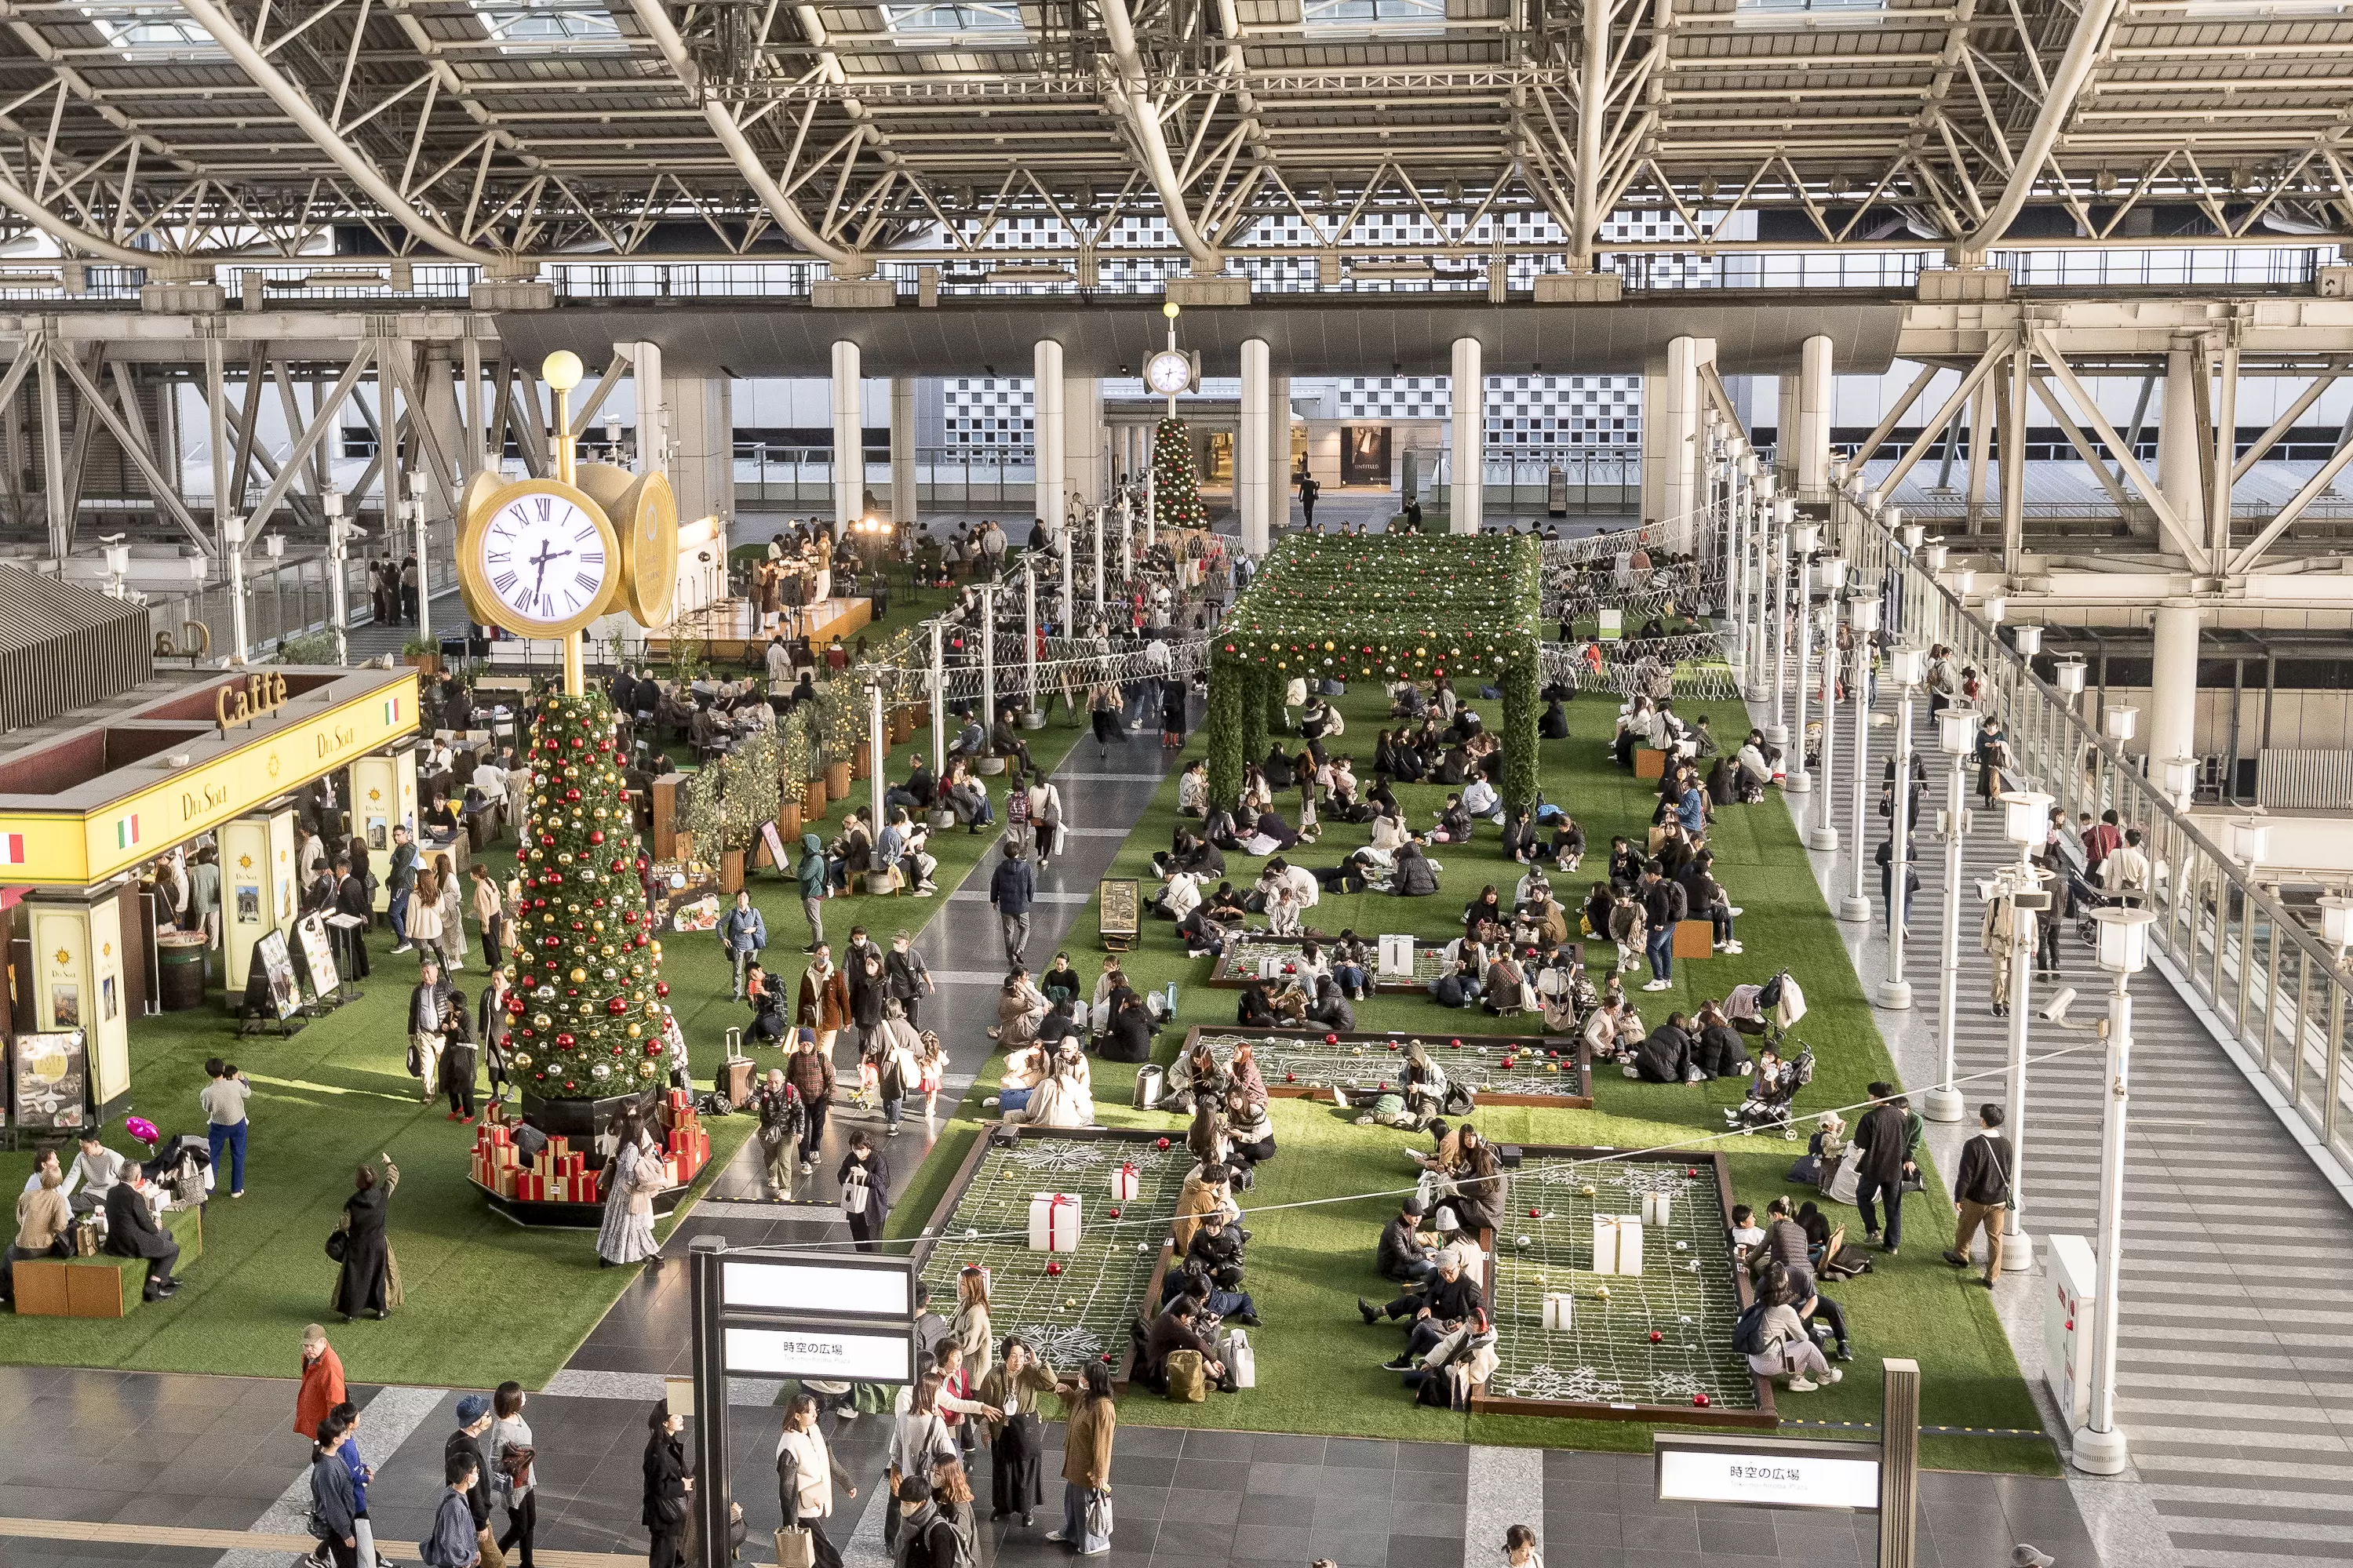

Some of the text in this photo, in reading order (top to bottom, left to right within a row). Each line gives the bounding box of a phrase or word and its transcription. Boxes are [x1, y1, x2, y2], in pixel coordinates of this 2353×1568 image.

[508, 503, 530, 529] XI
[534, 498, 552, 522] XII
[561, 505, 574, 526] I
[493, 523, 516, 543] X
[574, 525, 596, 543] II
[488, 550, 511, 564] IX
[581, 552, 603, 564] III
[574, 571, 599, 595] IIII
[542, 594, 555, 617] VI
[564, 589, 581, 612] V
[216, 671, 288, 729] Caffè
[651, 864, 683, 873] RRACE
[784, 1341, 843, 1355] 時空の広場
[1730, 1465, 1800, 1481] 時空の広場
